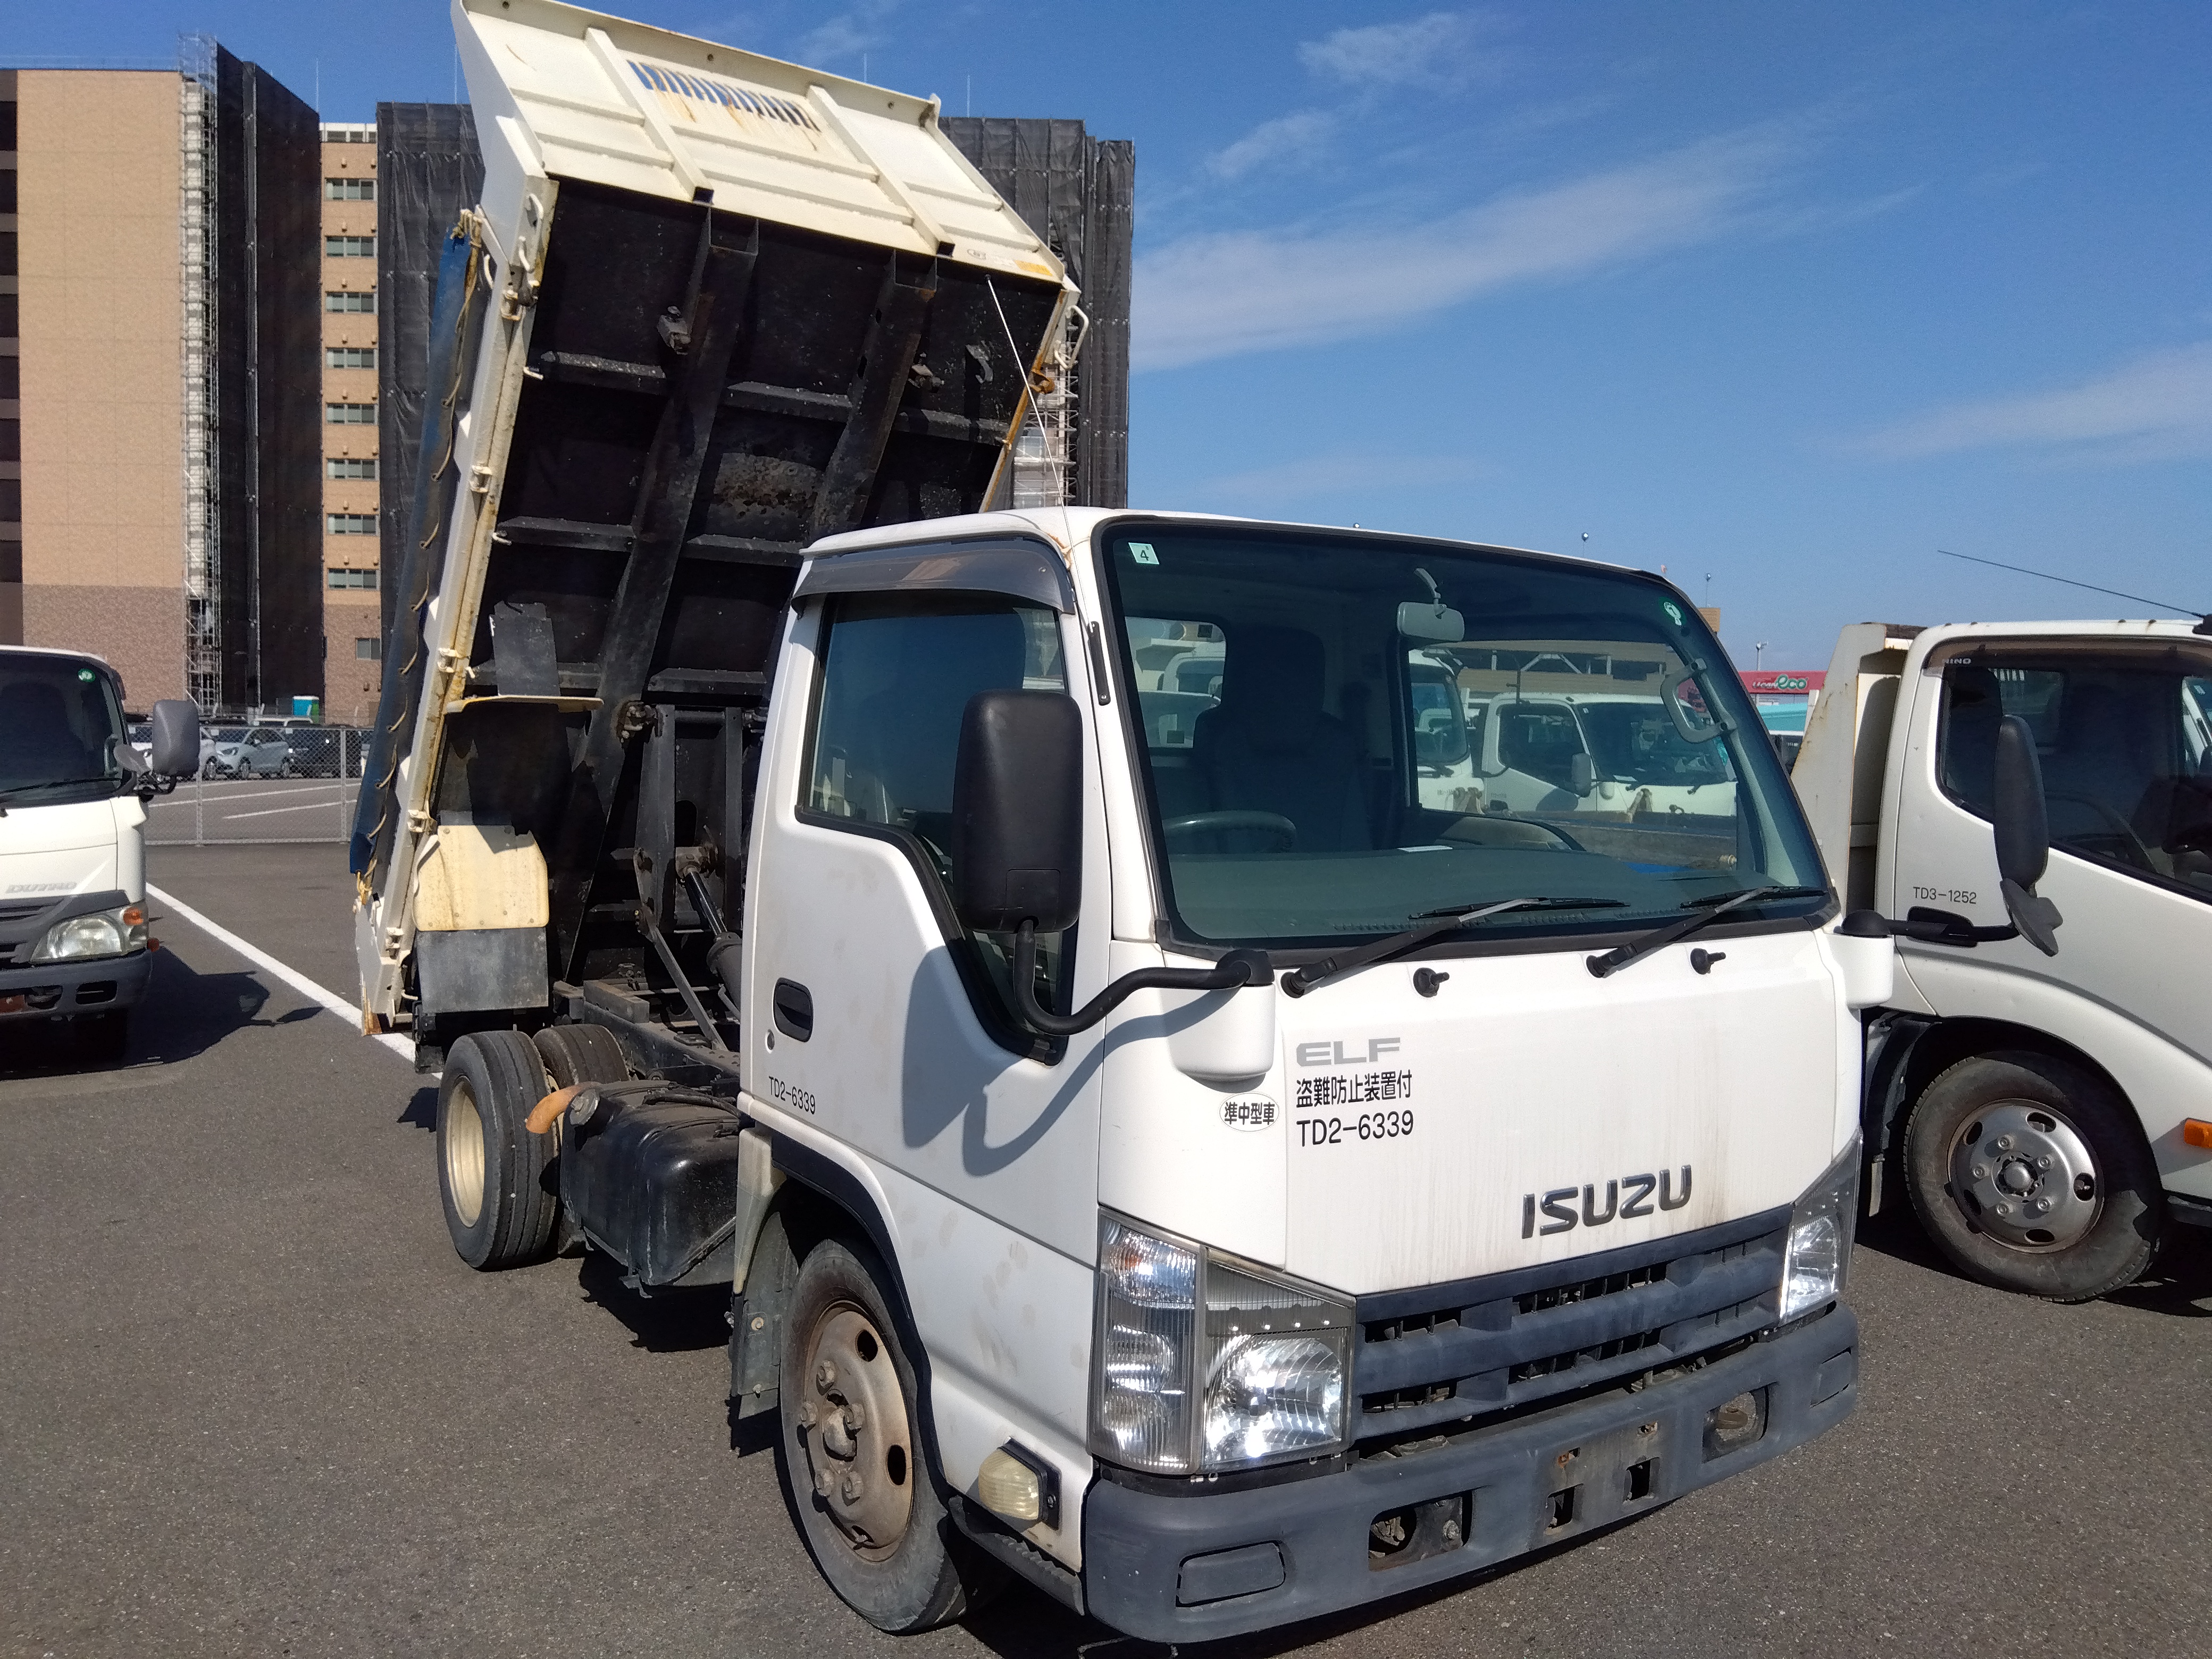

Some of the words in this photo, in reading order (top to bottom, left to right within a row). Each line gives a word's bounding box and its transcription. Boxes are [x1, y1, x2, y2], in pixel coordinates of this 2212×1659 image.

[1140, 549, 1149, 561] 4
[1777, 674, 1808, 690] eco
[1913, 886, 1977, 904] TD3-1252
[1296, 1037, 1401, 1067] ELF
[768, 1075, 816, 1115] TD2-6339
[1296, 1069, 1412, 1108] 盗難防止装置付
[1224, 1101, 1275, 1126] 準中型車
[1296, 1109, 1414, 1147] TD2-6339
[1521, 1164, 1692, 1239] ISUZU
